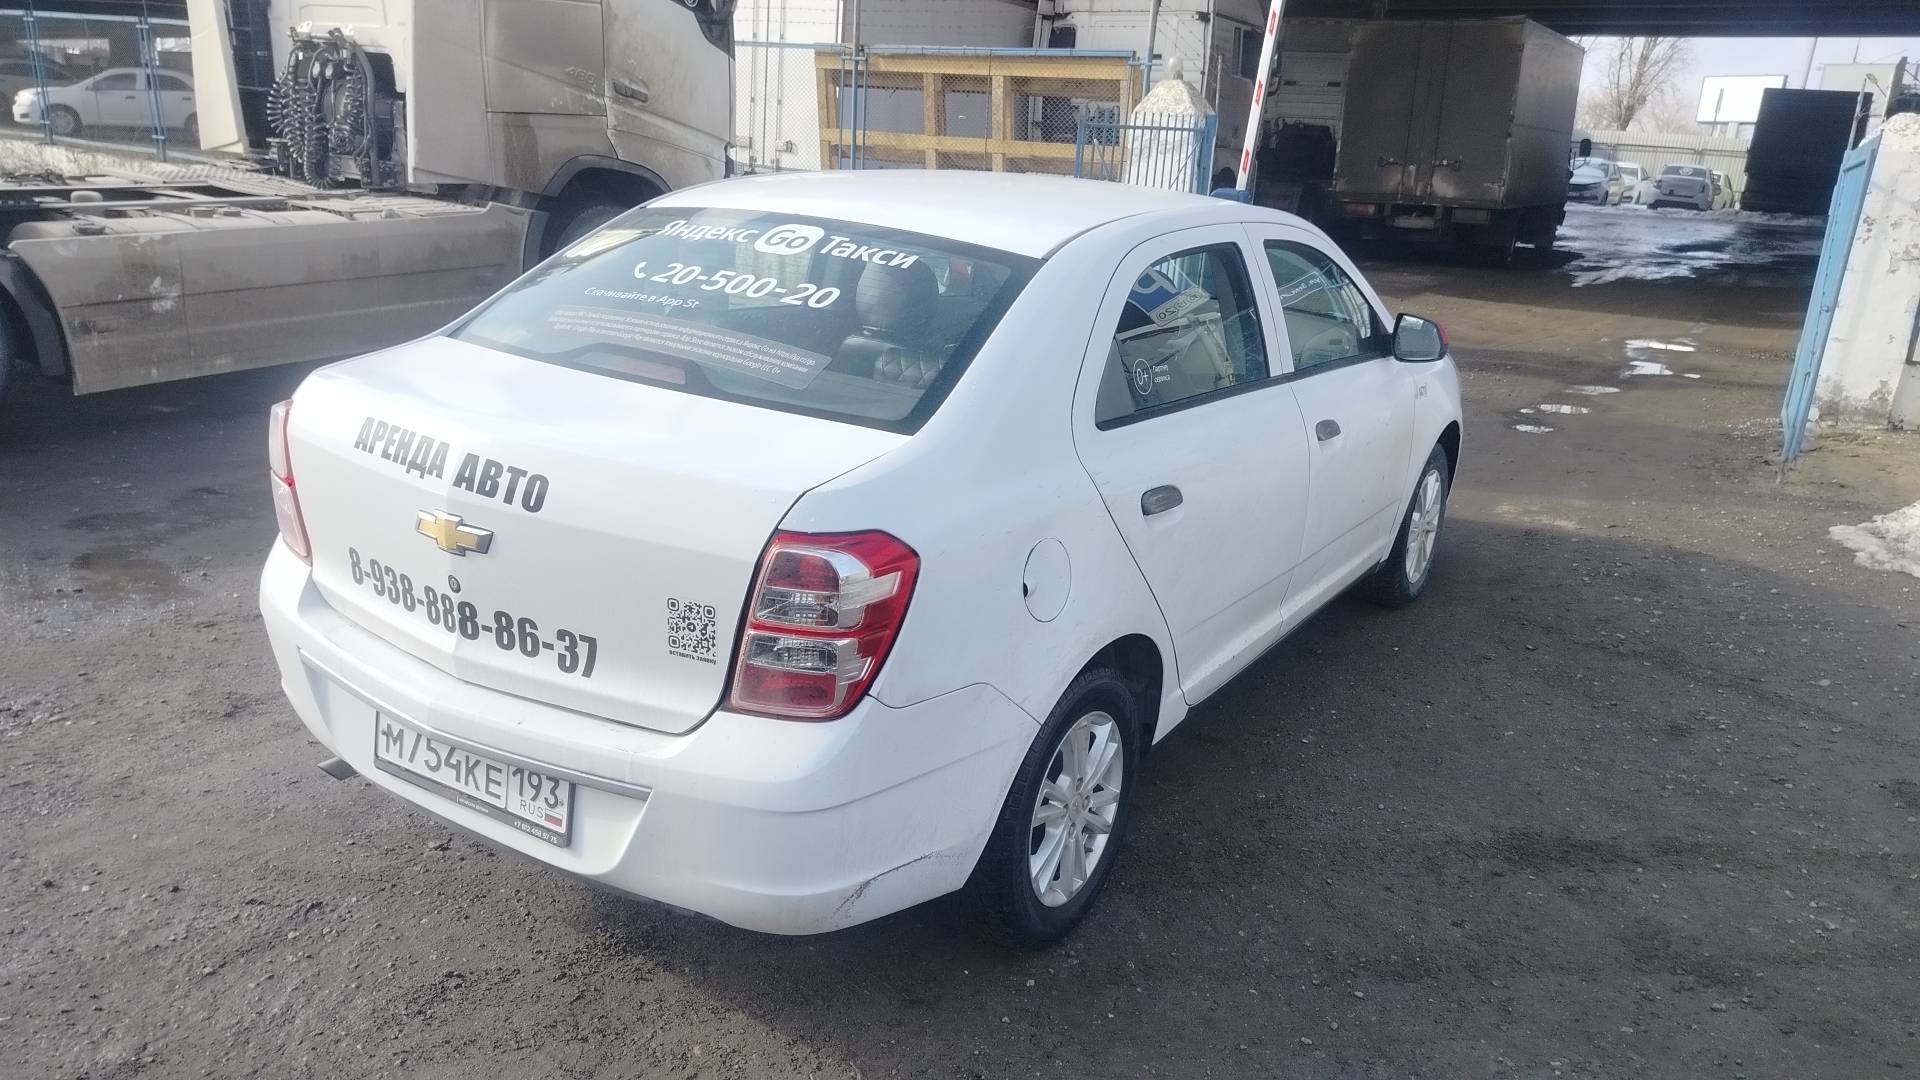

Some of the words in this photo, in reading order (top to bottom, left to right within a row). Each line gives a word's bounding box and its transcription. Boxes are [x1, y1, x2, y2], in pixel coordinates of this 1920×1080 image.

[656, 220, 760, 243] Яндекс
[764, 229, 808, 250] Go
[819, 236, 919, 269] Такси
[584, 287, 647, 301] Скачивайте
[656, 296, 681, 307] App
[650, 262, 841, 309] 20-500-20
[1136, 368, 1149, 385] 0+
[354, 416, 450, 480] АРЕНДА
[452, 453, 550, 513] АВТО
[348, 546, 598, 679] 8-938-888-86-37
[512, 767, 560, 810] 193
[519, 799, 544, 819] RUS
